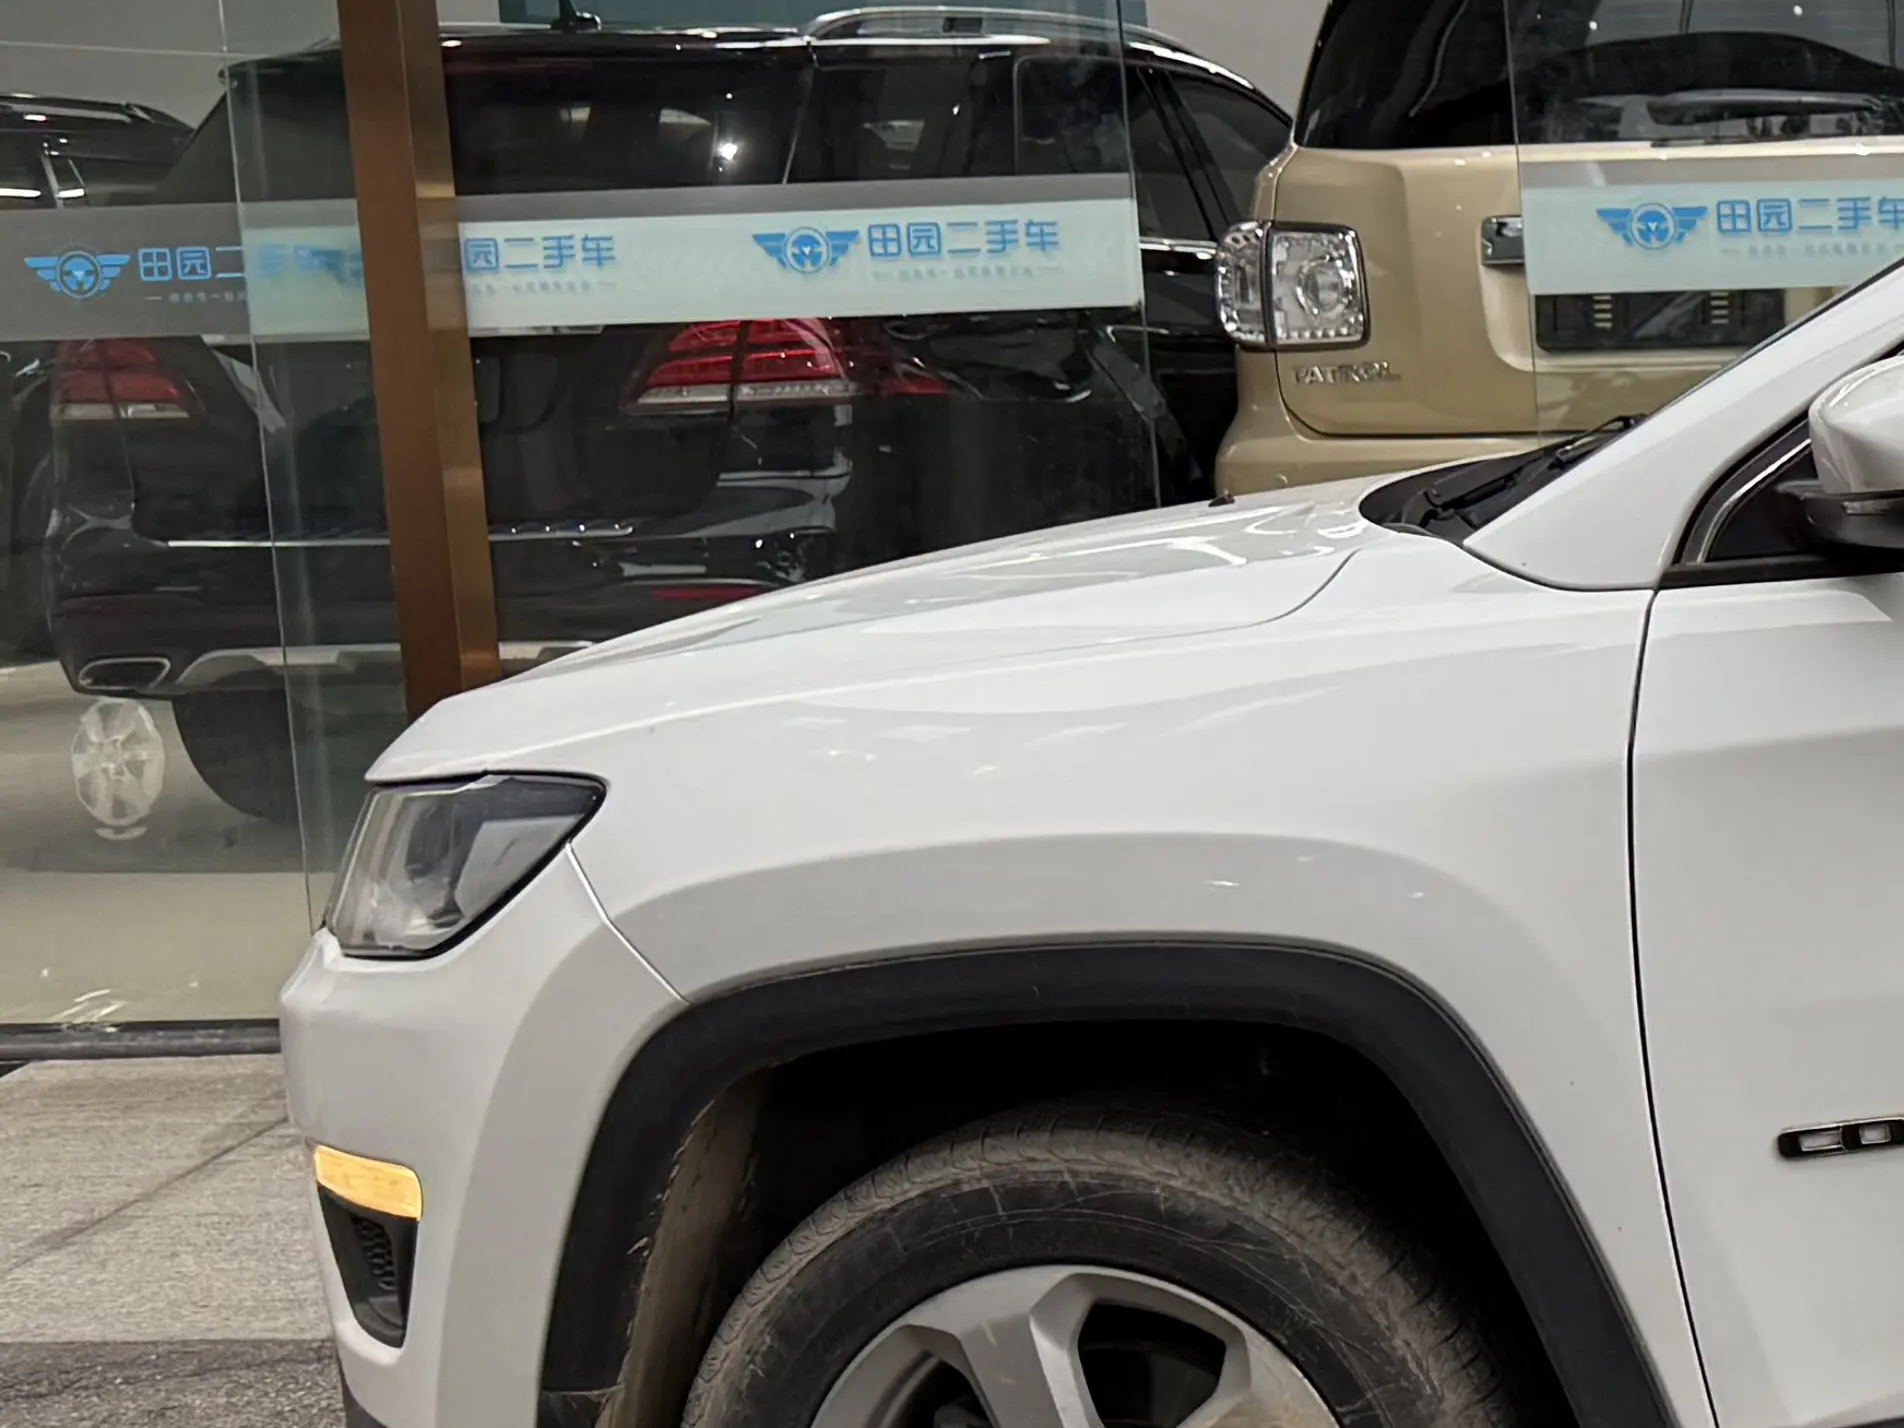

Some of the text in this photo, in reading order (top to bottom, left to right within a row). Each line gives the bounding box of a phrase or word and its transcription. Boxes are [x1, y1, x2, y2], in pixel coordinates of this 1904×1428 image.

[463, 234, 617, 273] 园二手车
[867, 218, 1060, 258] 田园二手车
